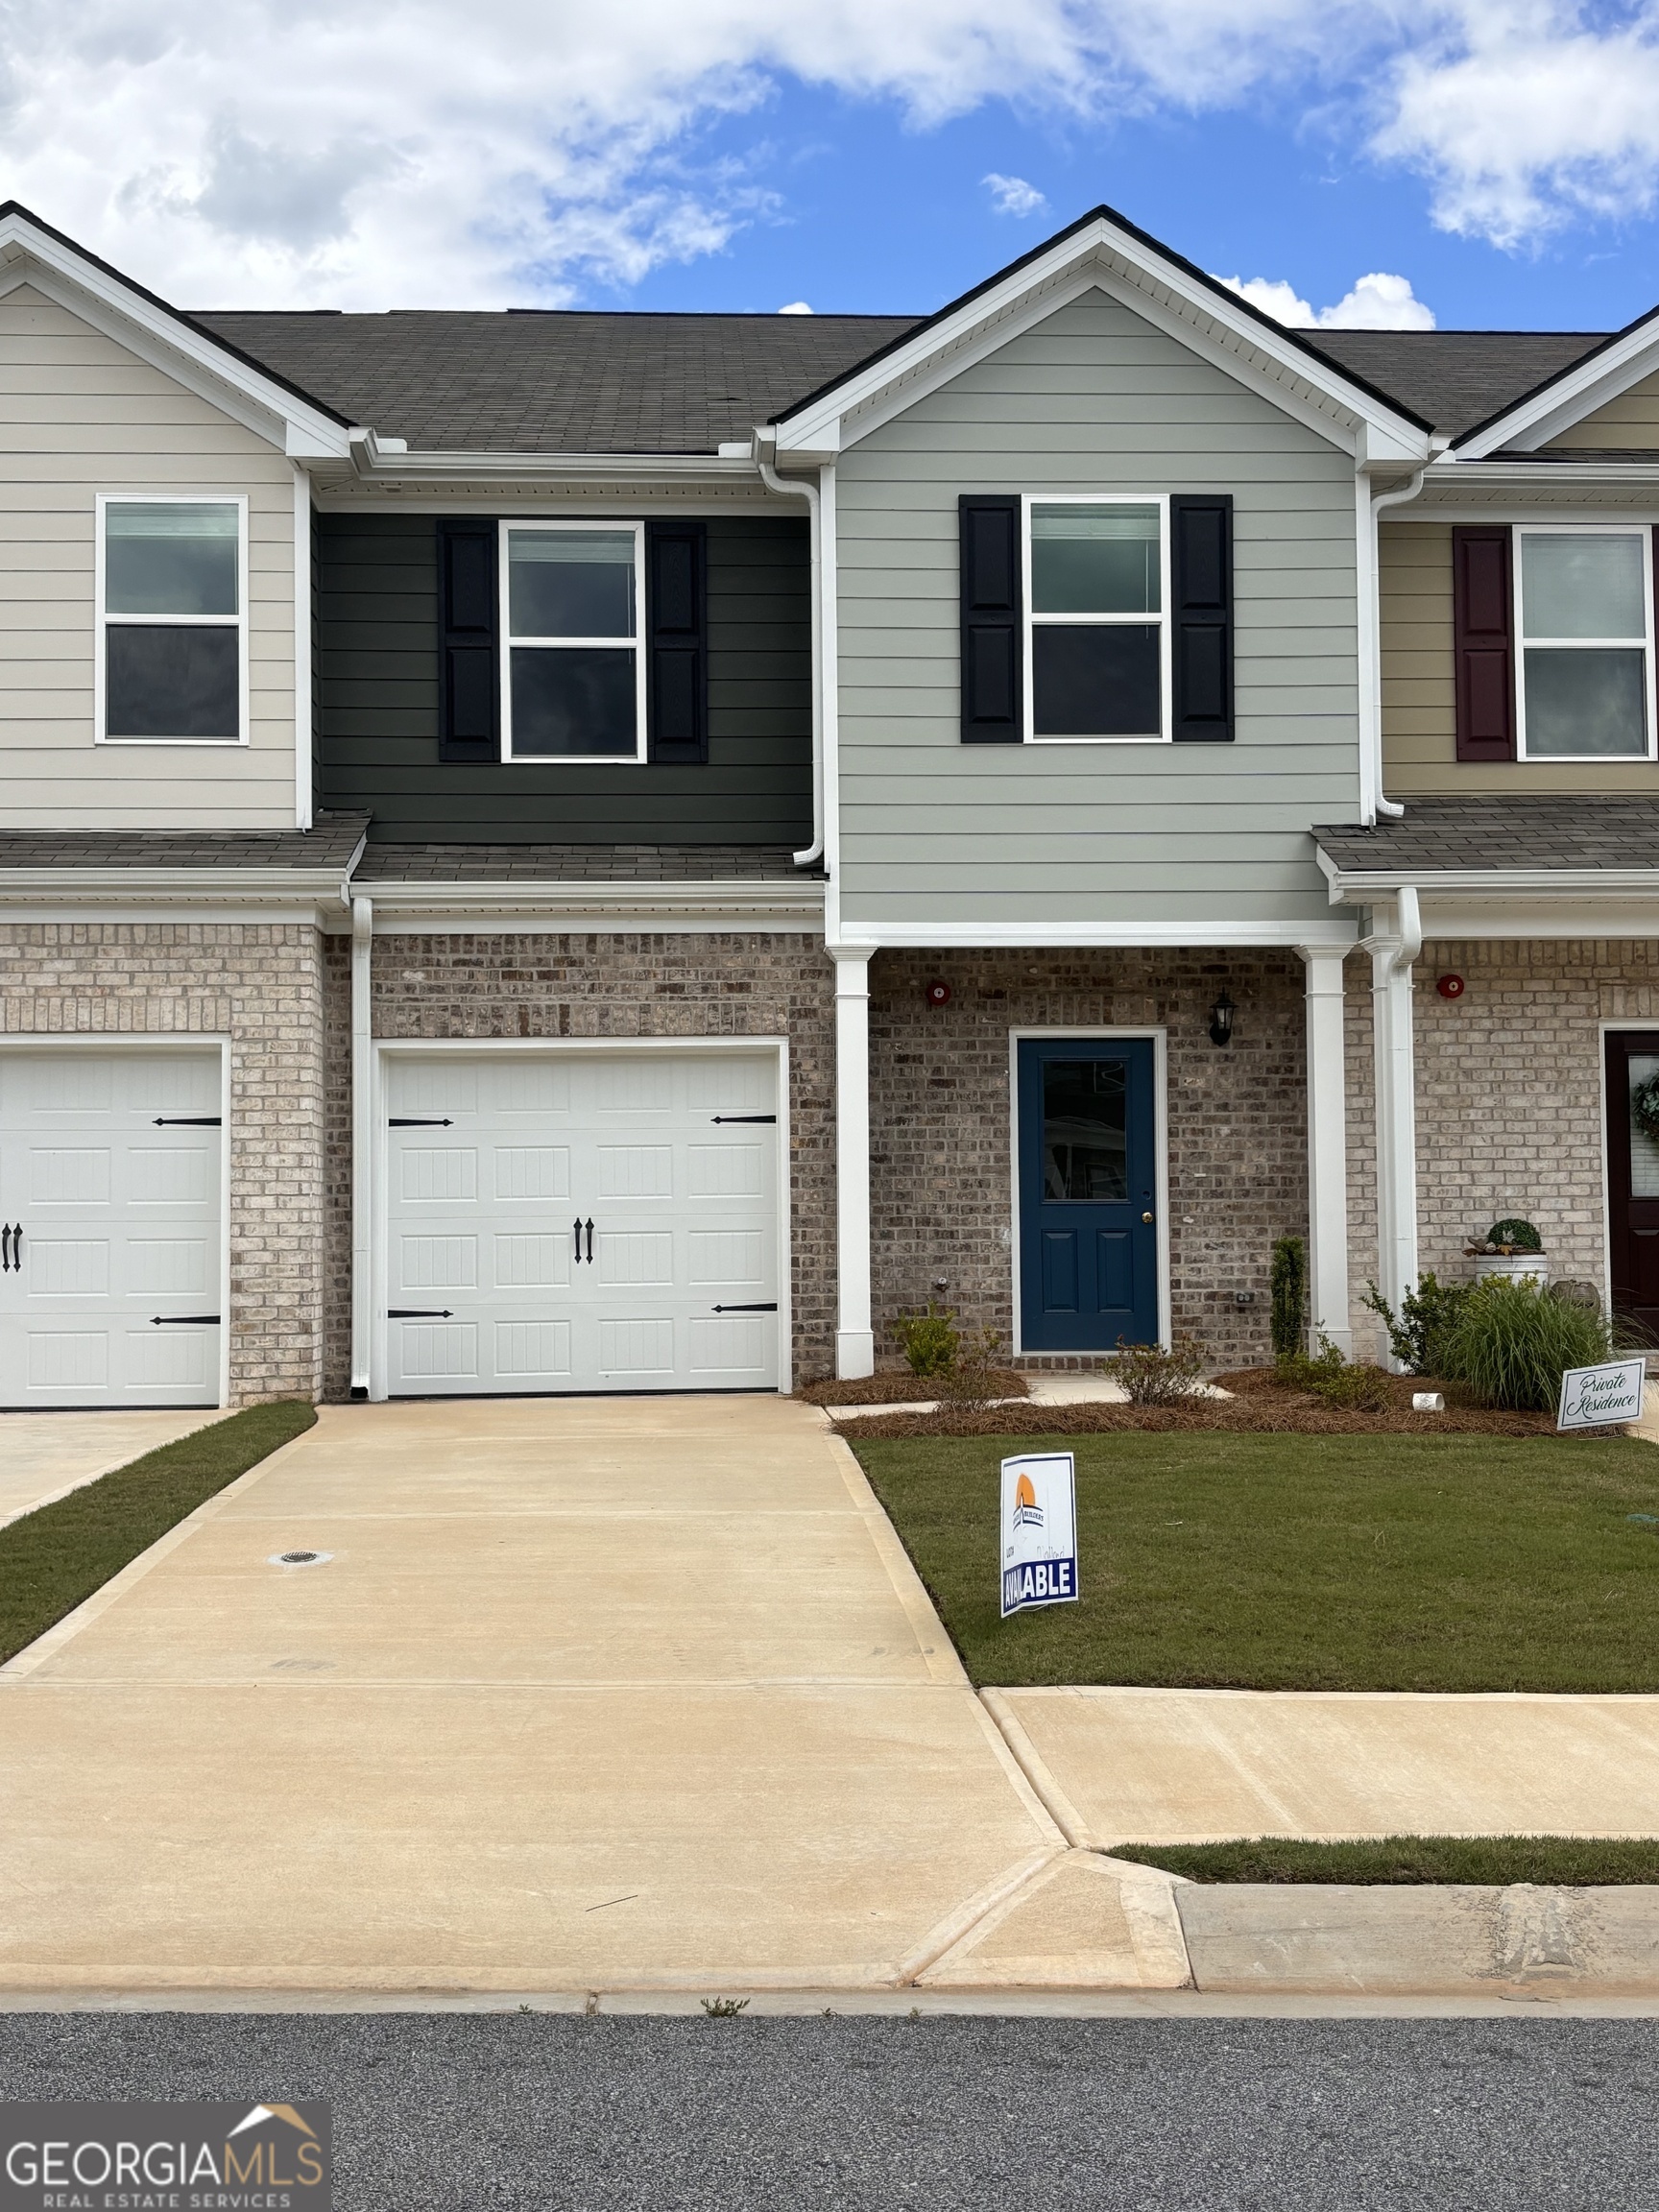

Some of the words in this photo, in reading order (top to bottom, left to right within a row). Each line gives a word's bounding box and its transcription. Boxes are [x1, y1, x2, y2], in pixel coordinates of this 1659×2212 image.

[1579, 1372, 1627, 1396] Private
[1566, 1393, 1637, 1419] Residence
[1005, 1562, 1070, 1608] AVAILABLE
